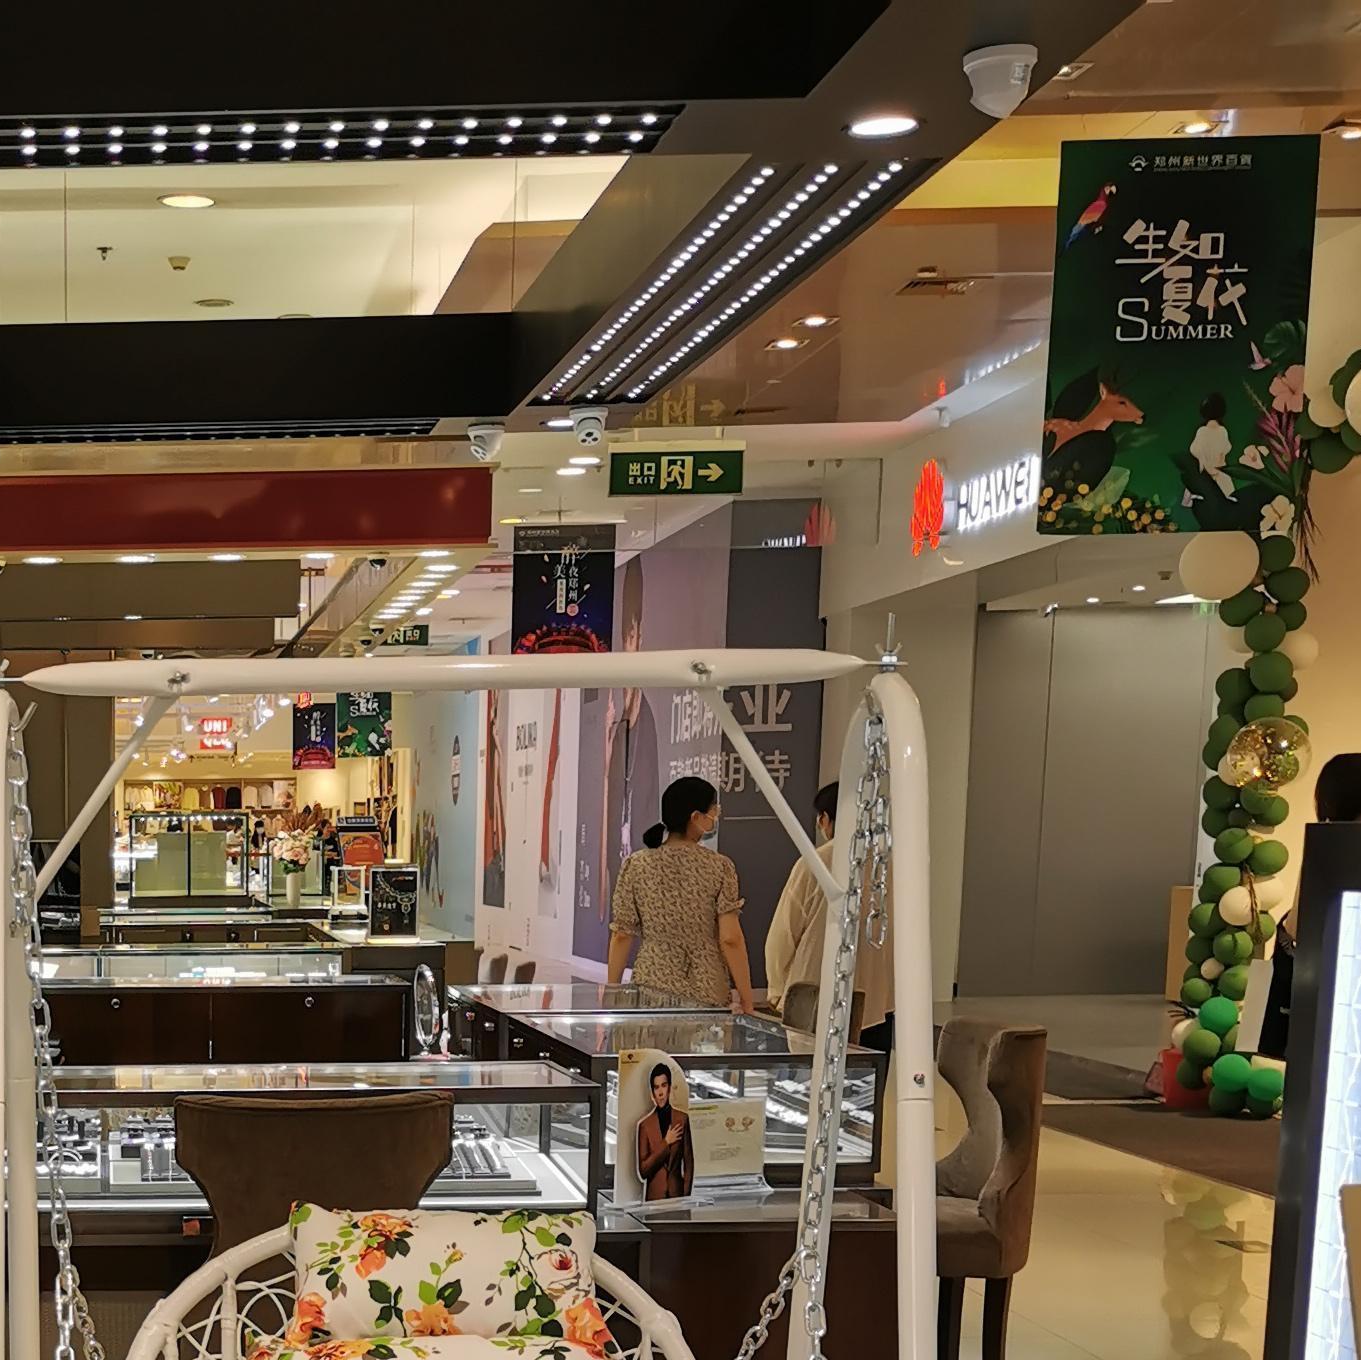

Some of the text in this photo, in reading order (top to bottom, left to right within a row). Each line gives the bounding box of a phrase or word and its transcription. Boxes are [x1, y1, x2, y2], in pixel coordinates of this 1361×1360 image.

[629, 462, 656, 476] 出口
[628, 476, 655, 485] EXIT
[956, 455, 1040, 533] HUAWEI
[203, 719, 227, 732] UNI
